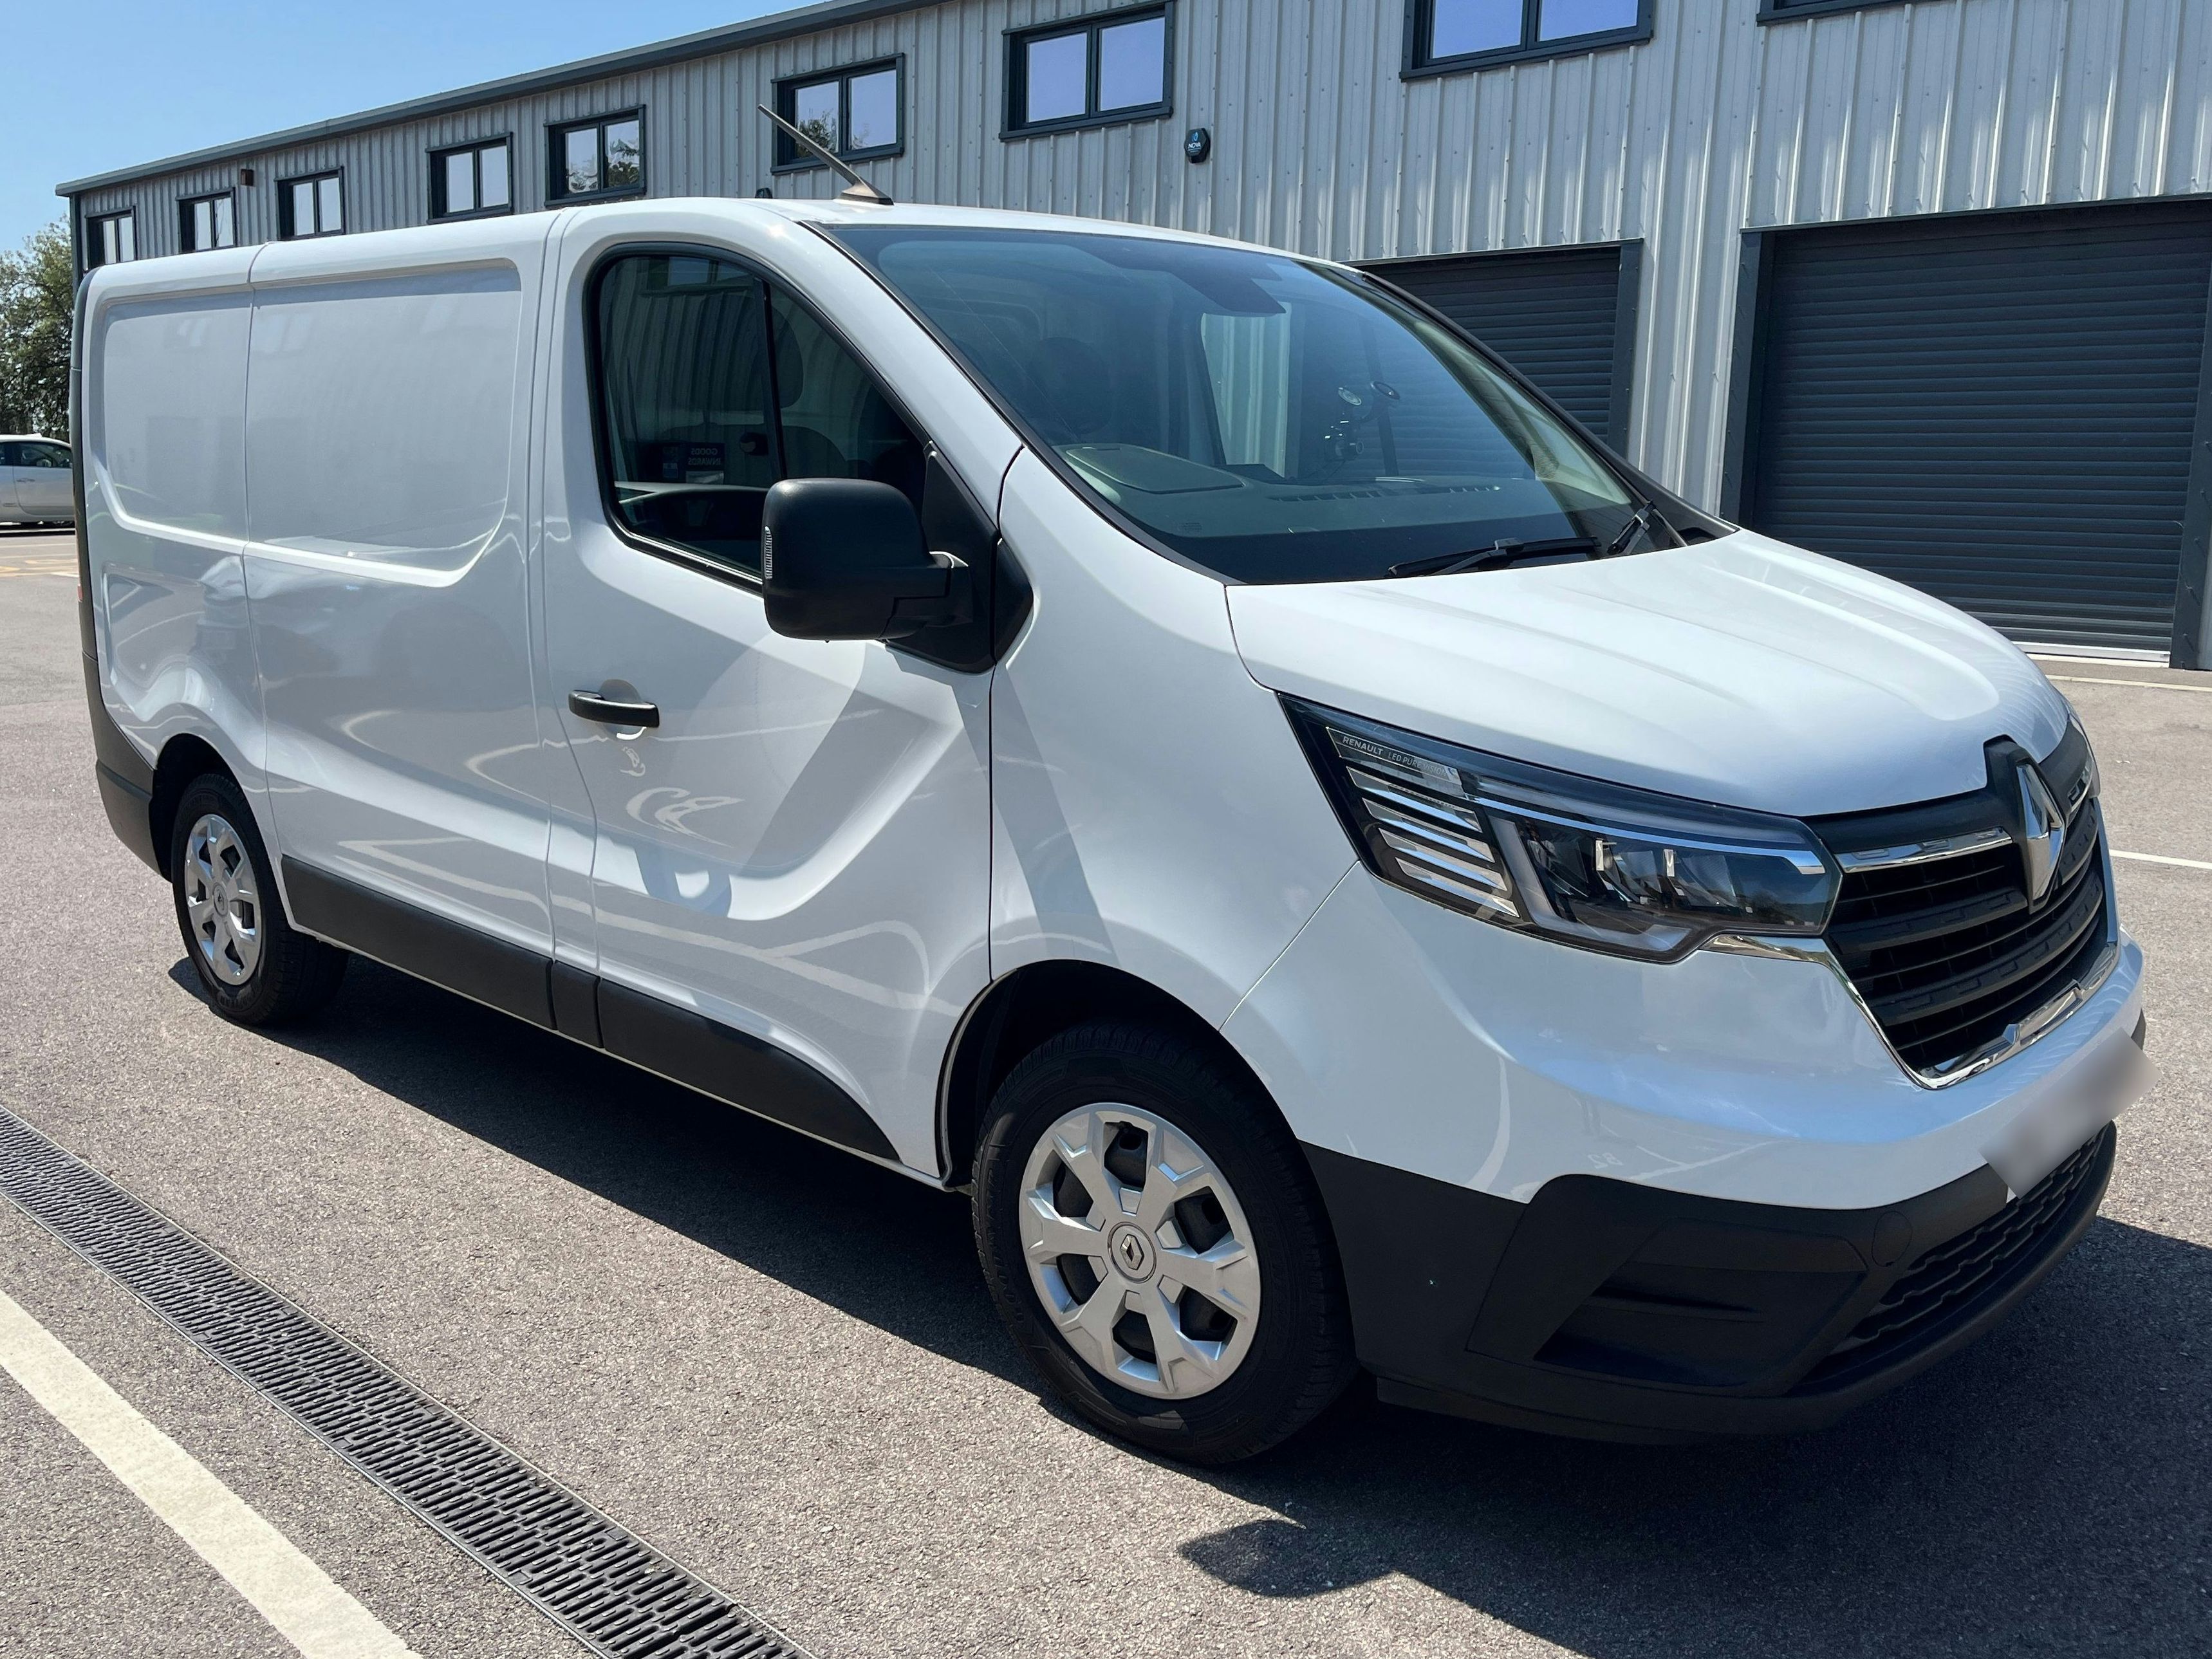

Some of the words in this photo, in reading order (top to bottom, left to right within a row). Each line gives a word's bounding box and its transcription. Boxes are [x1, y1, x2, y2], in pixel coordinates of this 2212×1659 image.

[1343, 736, 1383, 755] RENAULT
[1388, 752, 1402, 763] LED
[1402, 757, 1422, 768] PURE
[1422, 763, 1447, 776] VISION
